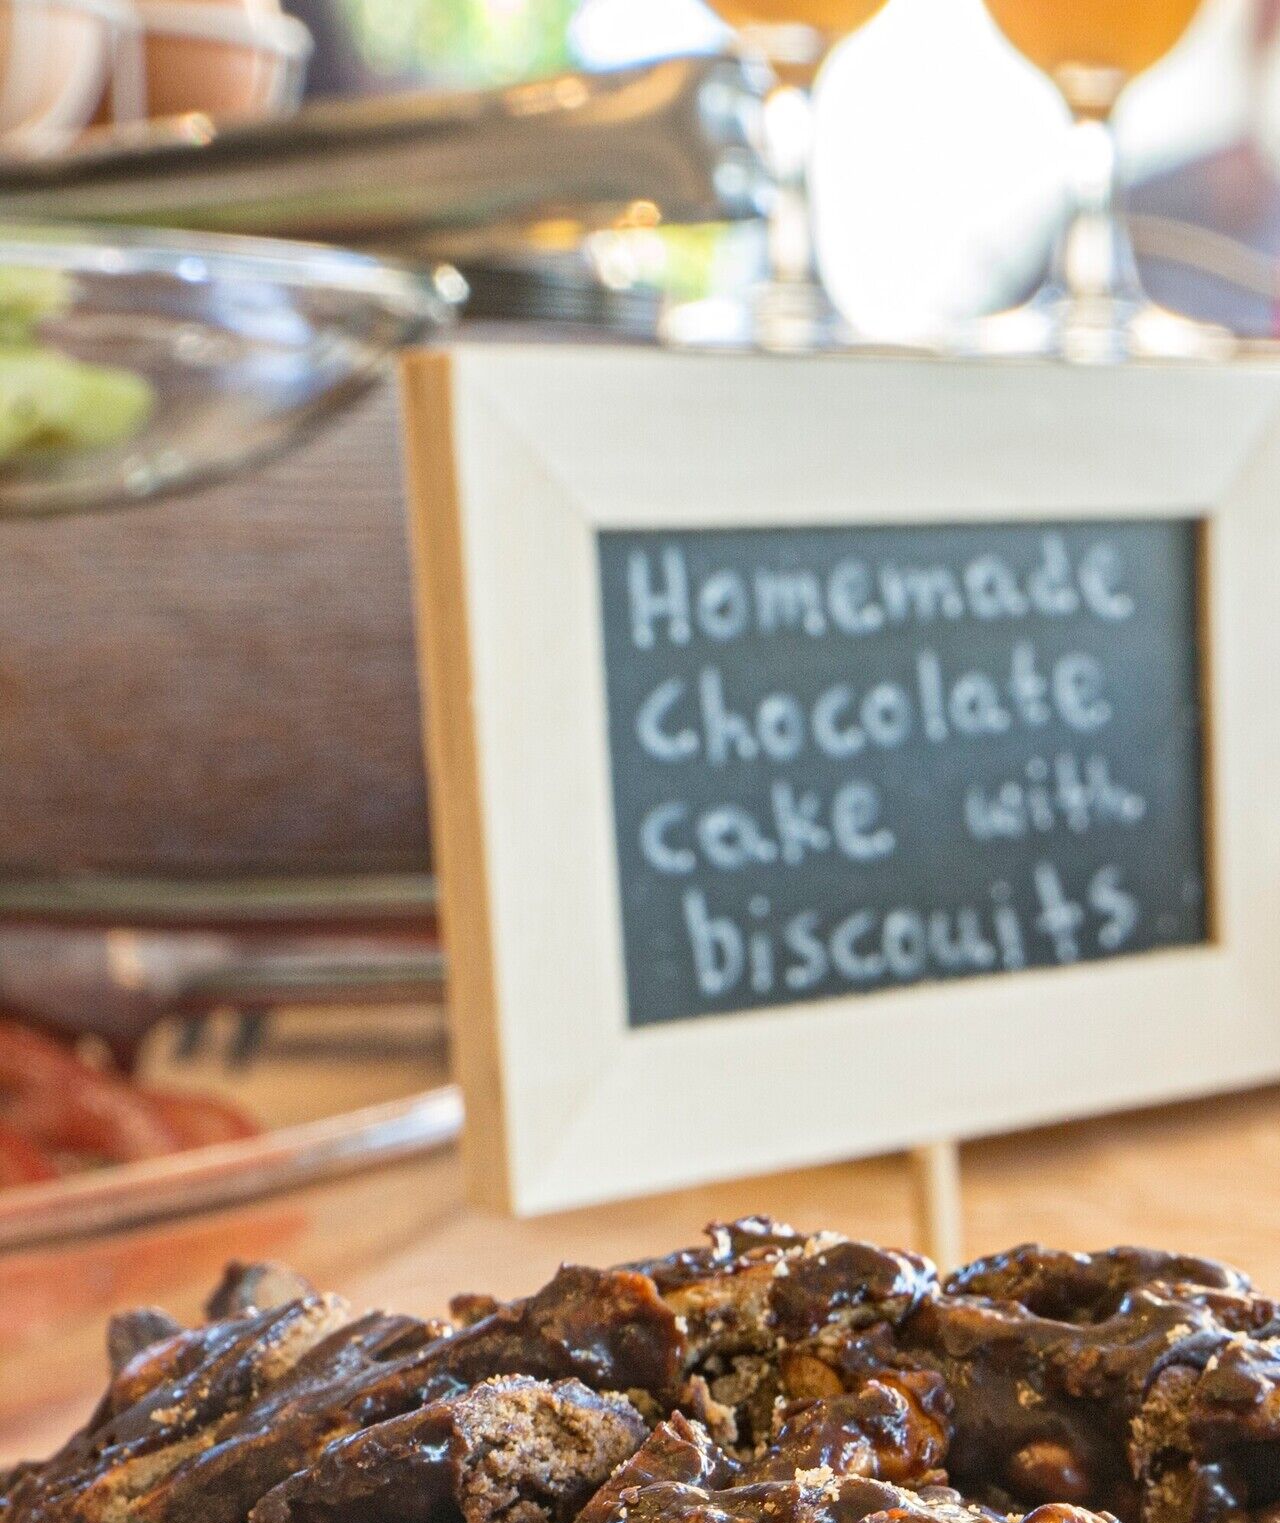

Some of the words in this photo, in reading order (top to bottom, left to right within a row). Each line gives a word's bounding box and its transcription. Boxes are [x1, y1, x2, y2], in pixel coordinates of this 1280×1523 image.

[628, 533, 1133, 649] Homemade
[639, 780, 895, 874] cake
[965, 753, 1146, 841] with
